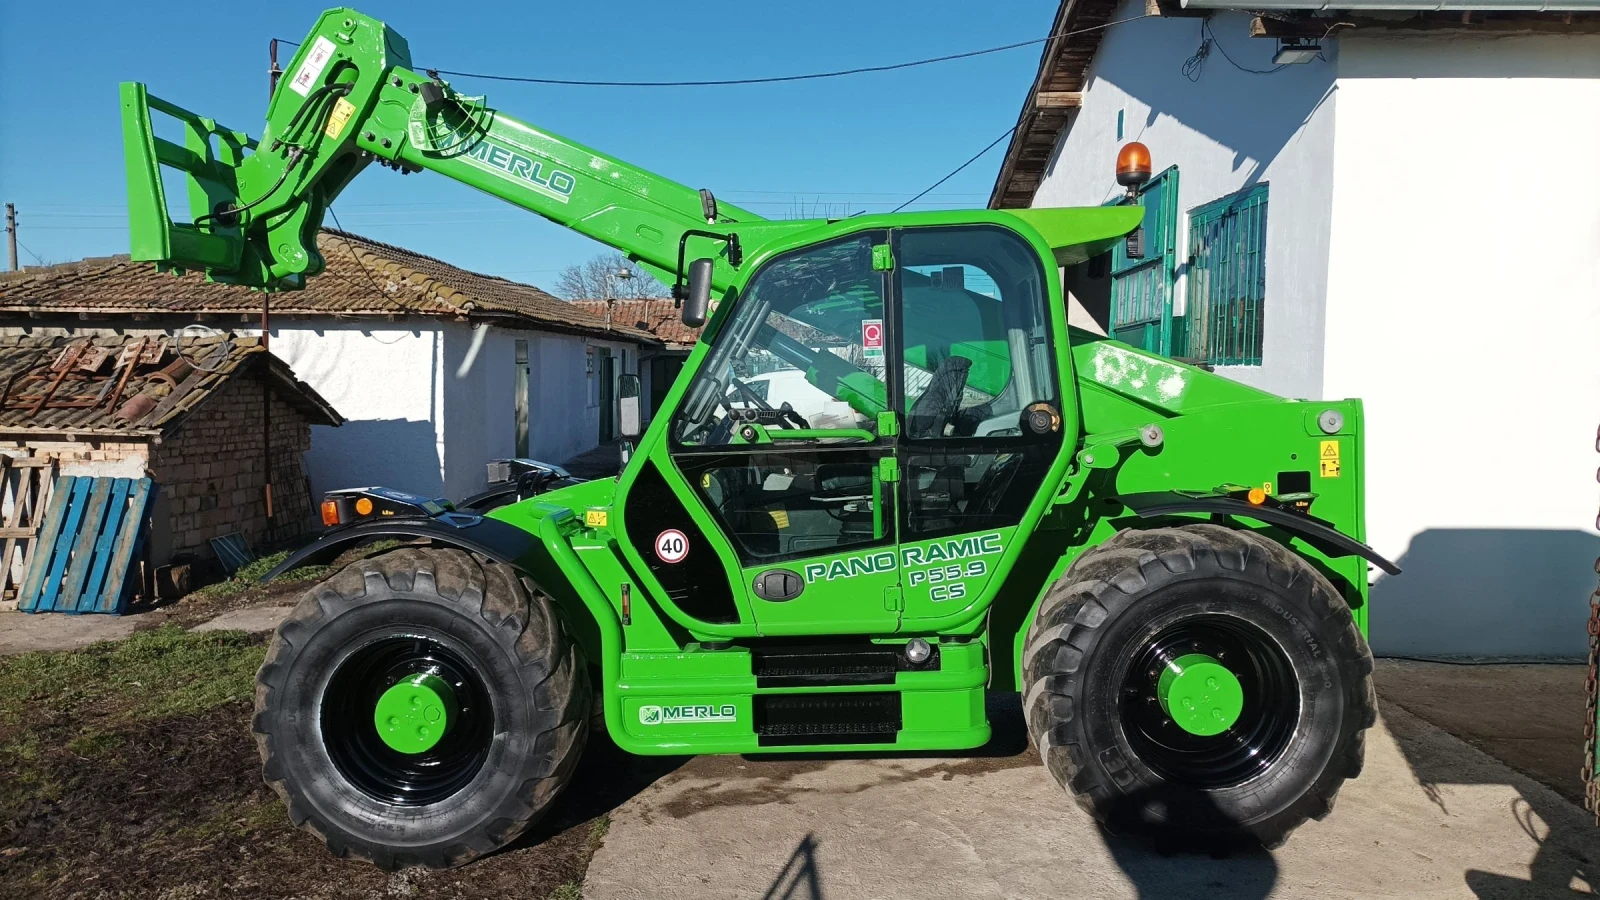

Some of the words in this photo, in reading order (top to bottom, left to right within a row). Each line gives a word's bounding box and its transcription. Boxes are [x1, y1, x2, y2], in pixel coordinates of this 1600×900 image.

[459, 134, 576, 196] MERLO
[661, 538, 683, 554] 40
[909, 561, 986, 586] P55.9
[930, 583, 965, 602] CS
[662, 704, 736, 719] MERLO
